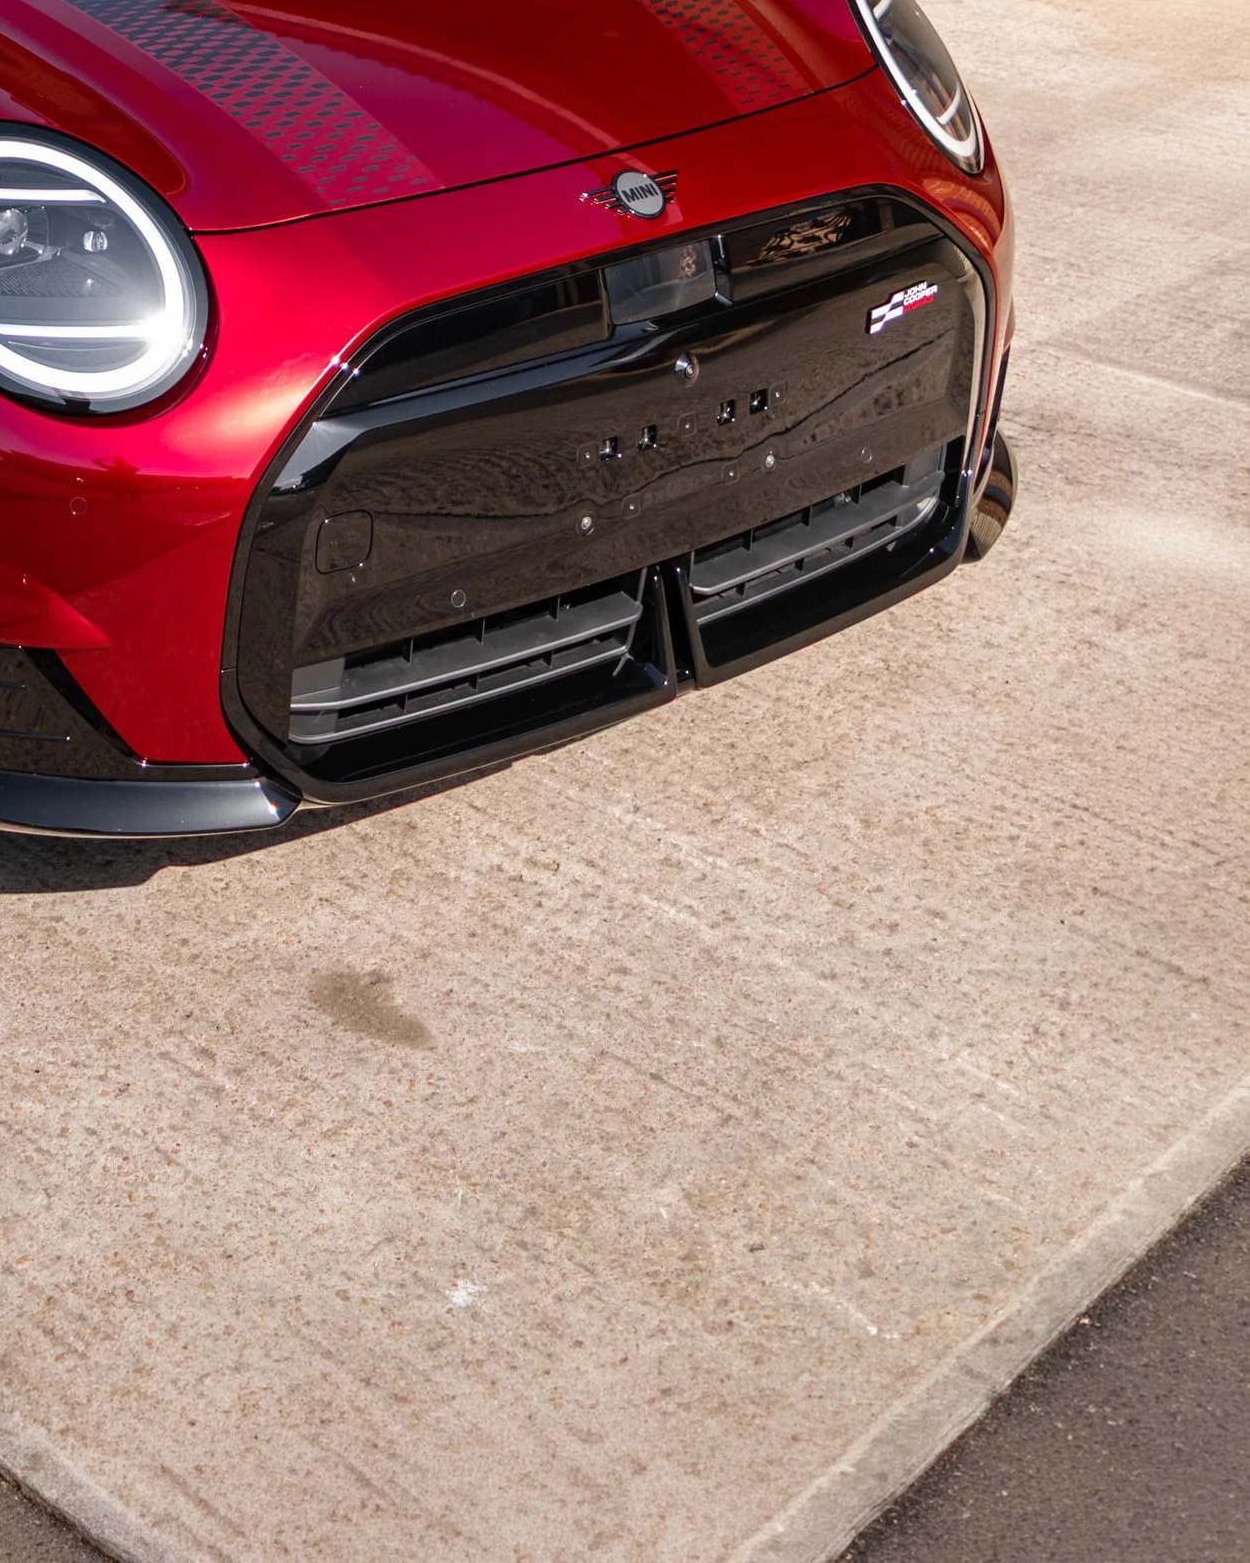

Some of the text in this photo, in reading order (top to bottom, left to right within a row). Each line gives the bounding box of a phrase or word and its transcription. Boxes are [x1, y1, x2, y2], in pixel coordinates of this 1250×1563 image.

[621, 183, 659, 202] MINI
[904, 281, 927, 298] JOHN
[904, 285, 938, 306] COOPER
